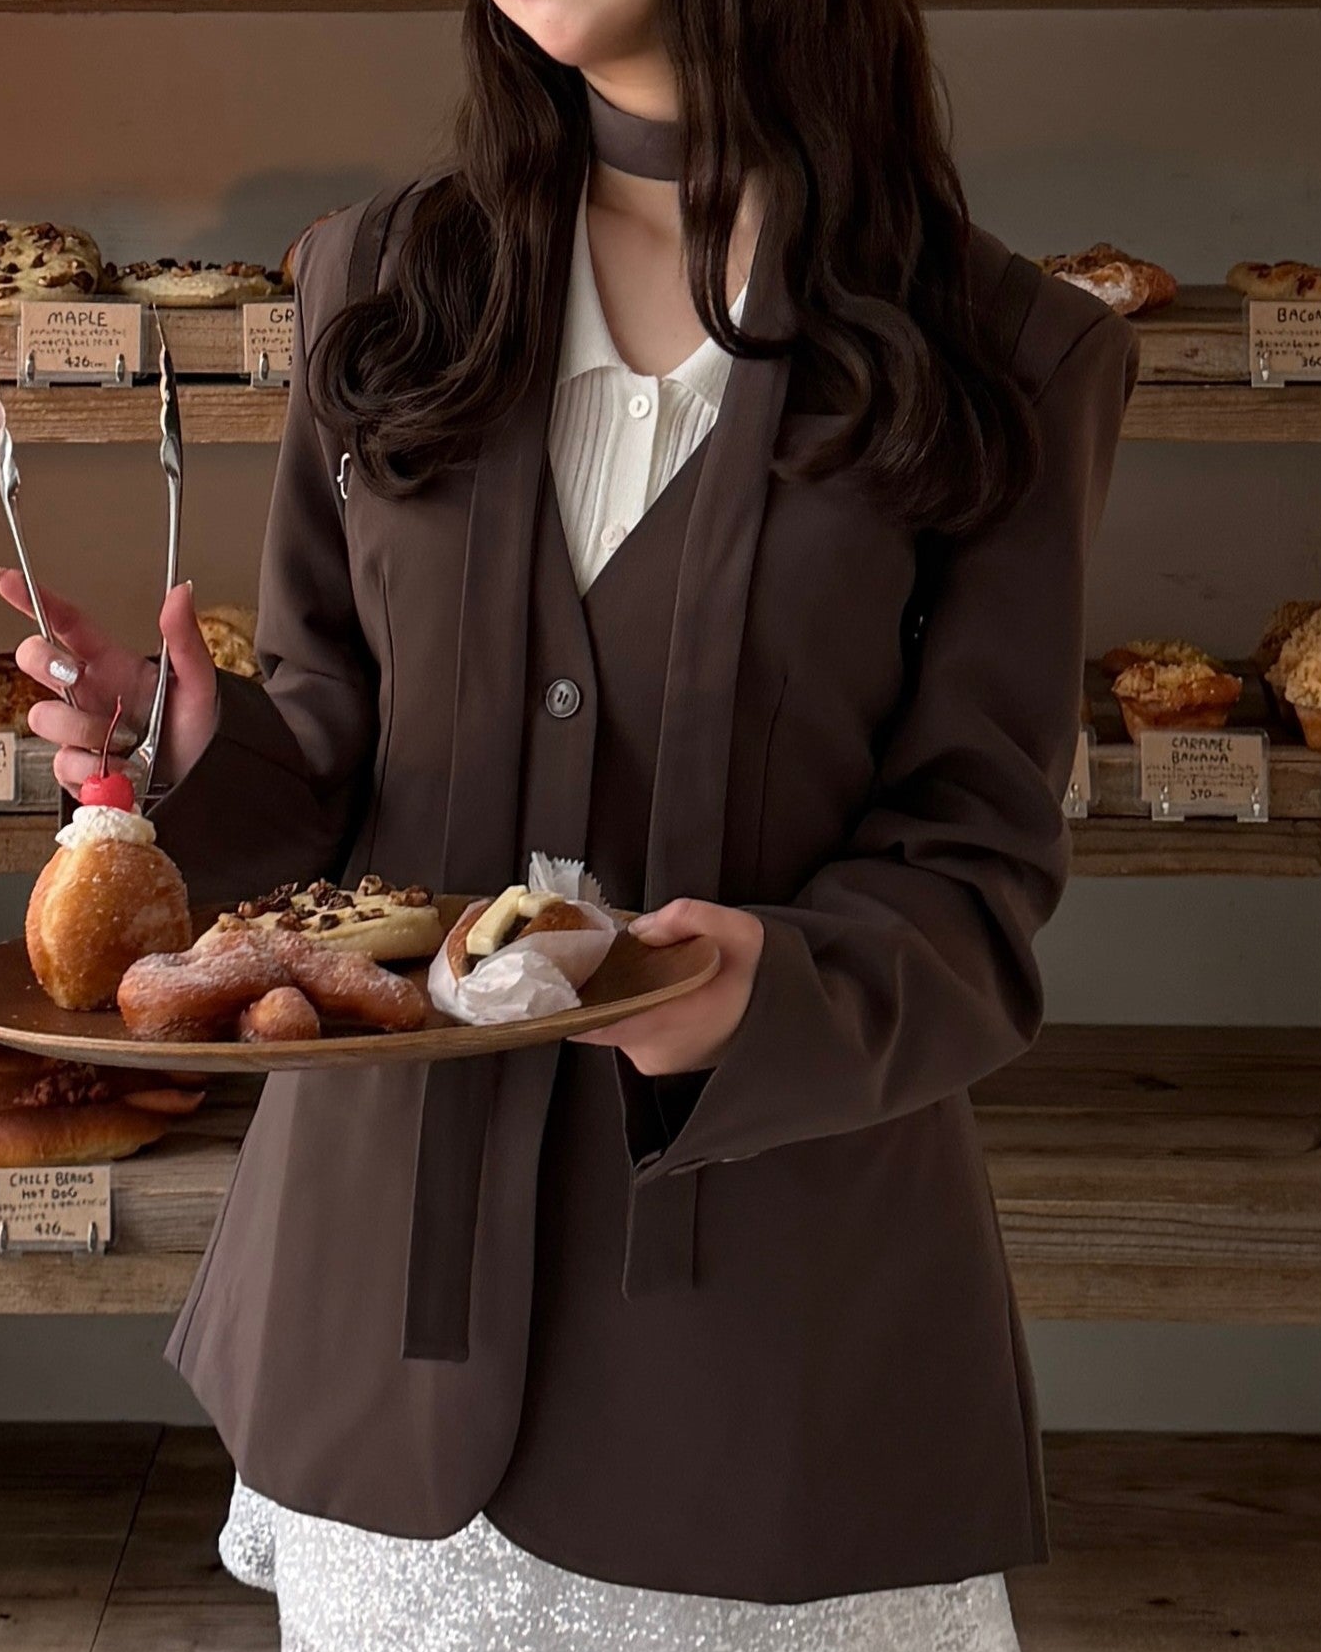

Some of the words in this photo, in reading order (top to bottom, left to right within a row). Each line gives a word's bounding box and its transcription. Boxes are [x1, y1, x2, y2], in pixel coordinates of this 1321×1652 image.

[47, 311, 108, 327] MAPLE
[1171, 736, 1232, 752] CARAMEL
[1171, 751, 1229, 764] BANANA
[10, 1173, 49, 1187] CHILI
[22, 1189, 45, 1199] HOT
[51, 1187, 78, 1199] DOG
